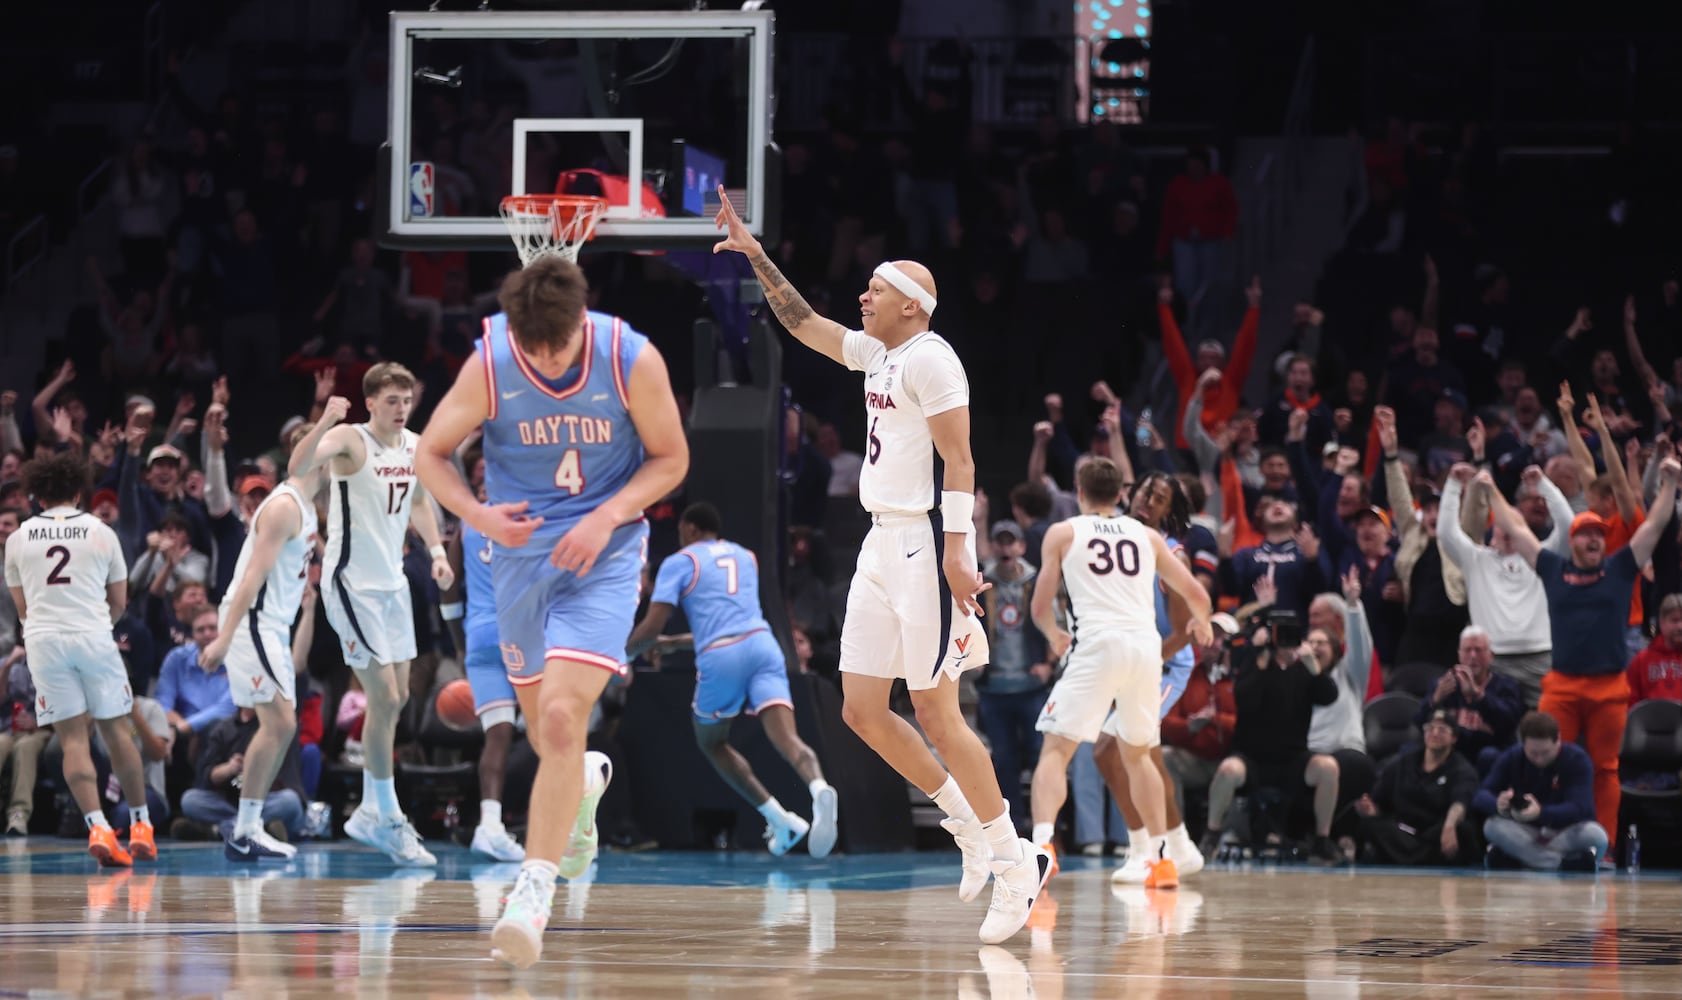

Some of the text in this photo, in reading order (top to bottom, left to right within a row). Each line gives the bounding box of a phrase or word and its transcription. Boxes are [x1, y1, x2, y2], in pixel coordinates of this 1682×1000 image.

[517, 414, 613, 446] DAYTON
[868, 416, 882, 466] 6
[555, 448, 586, 497] 4
[387, 481, 409, 515] 17
[28, 527, 88, 541] MALLORY
[1093, 522, 1125, 535] HALL
[46, 544, 71, 586] 2
[715, 557, 739, 596] 7
[1087, 538, 1140, 577] 30
